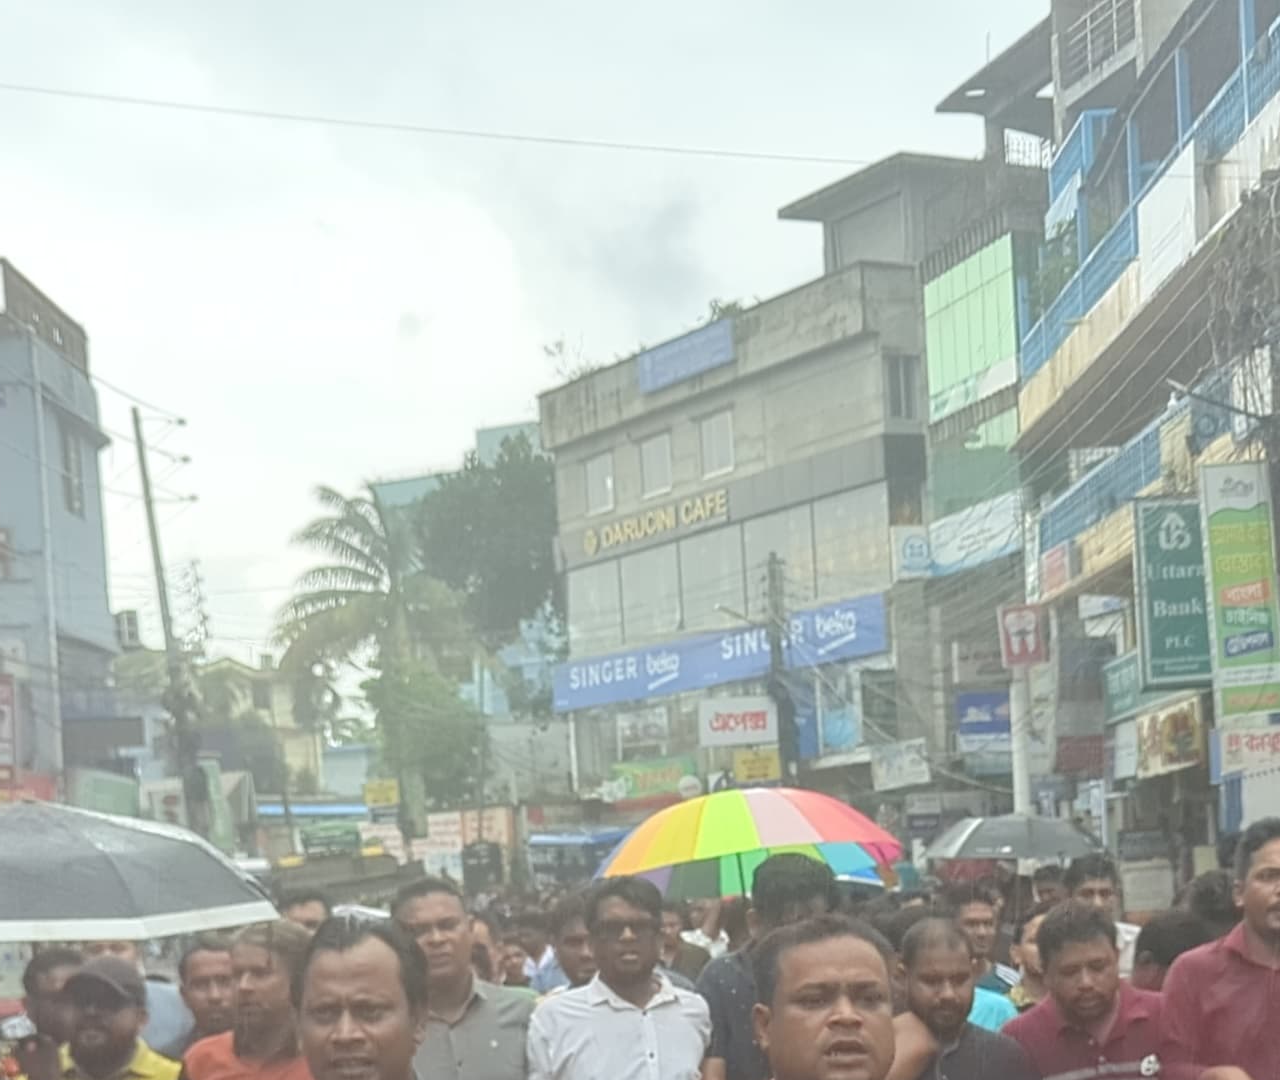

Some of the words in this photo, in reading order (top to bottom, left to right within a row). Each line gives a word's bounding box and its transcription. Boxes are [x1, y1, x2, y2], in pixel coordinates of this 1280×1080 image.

[601, 506, 676, 548] DARUCINI
[681, 488, 729, 526] CAFE
[1153, 598, 1204, 618] Bank
[570, 658, 637, 690] SINGER
[646, 652, 680, 675] beko
[815, 610, 856, 638] beko
[1166, 634, 1195, 649] PLC
